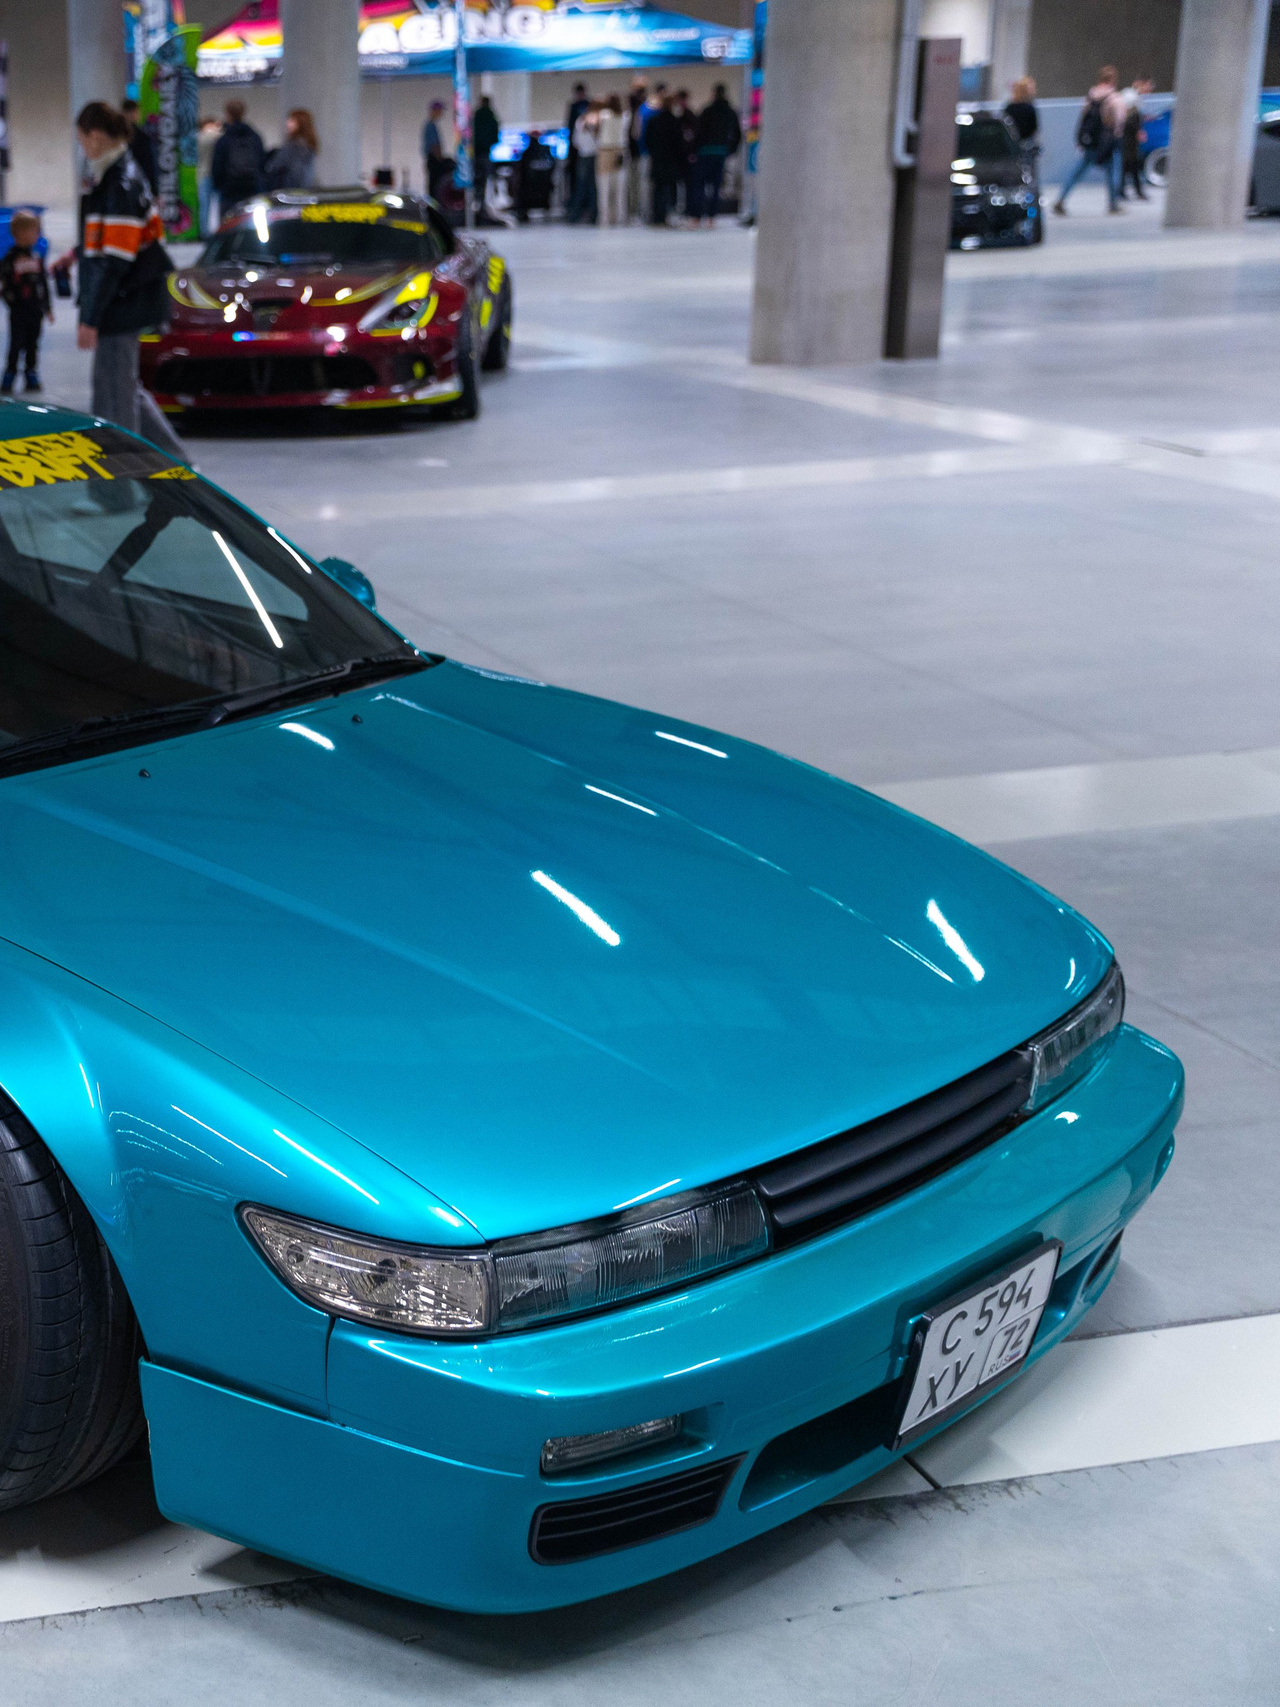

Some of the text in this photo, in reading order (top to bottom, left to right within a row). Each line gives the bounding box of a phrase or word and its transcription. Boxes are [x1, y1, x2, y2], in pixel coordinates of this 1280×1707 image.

[975, 1268, 1035, 1336] 594
[998, 1318, 1030, 1359] 72
[988, 1355, 1010, 1376] RUS
